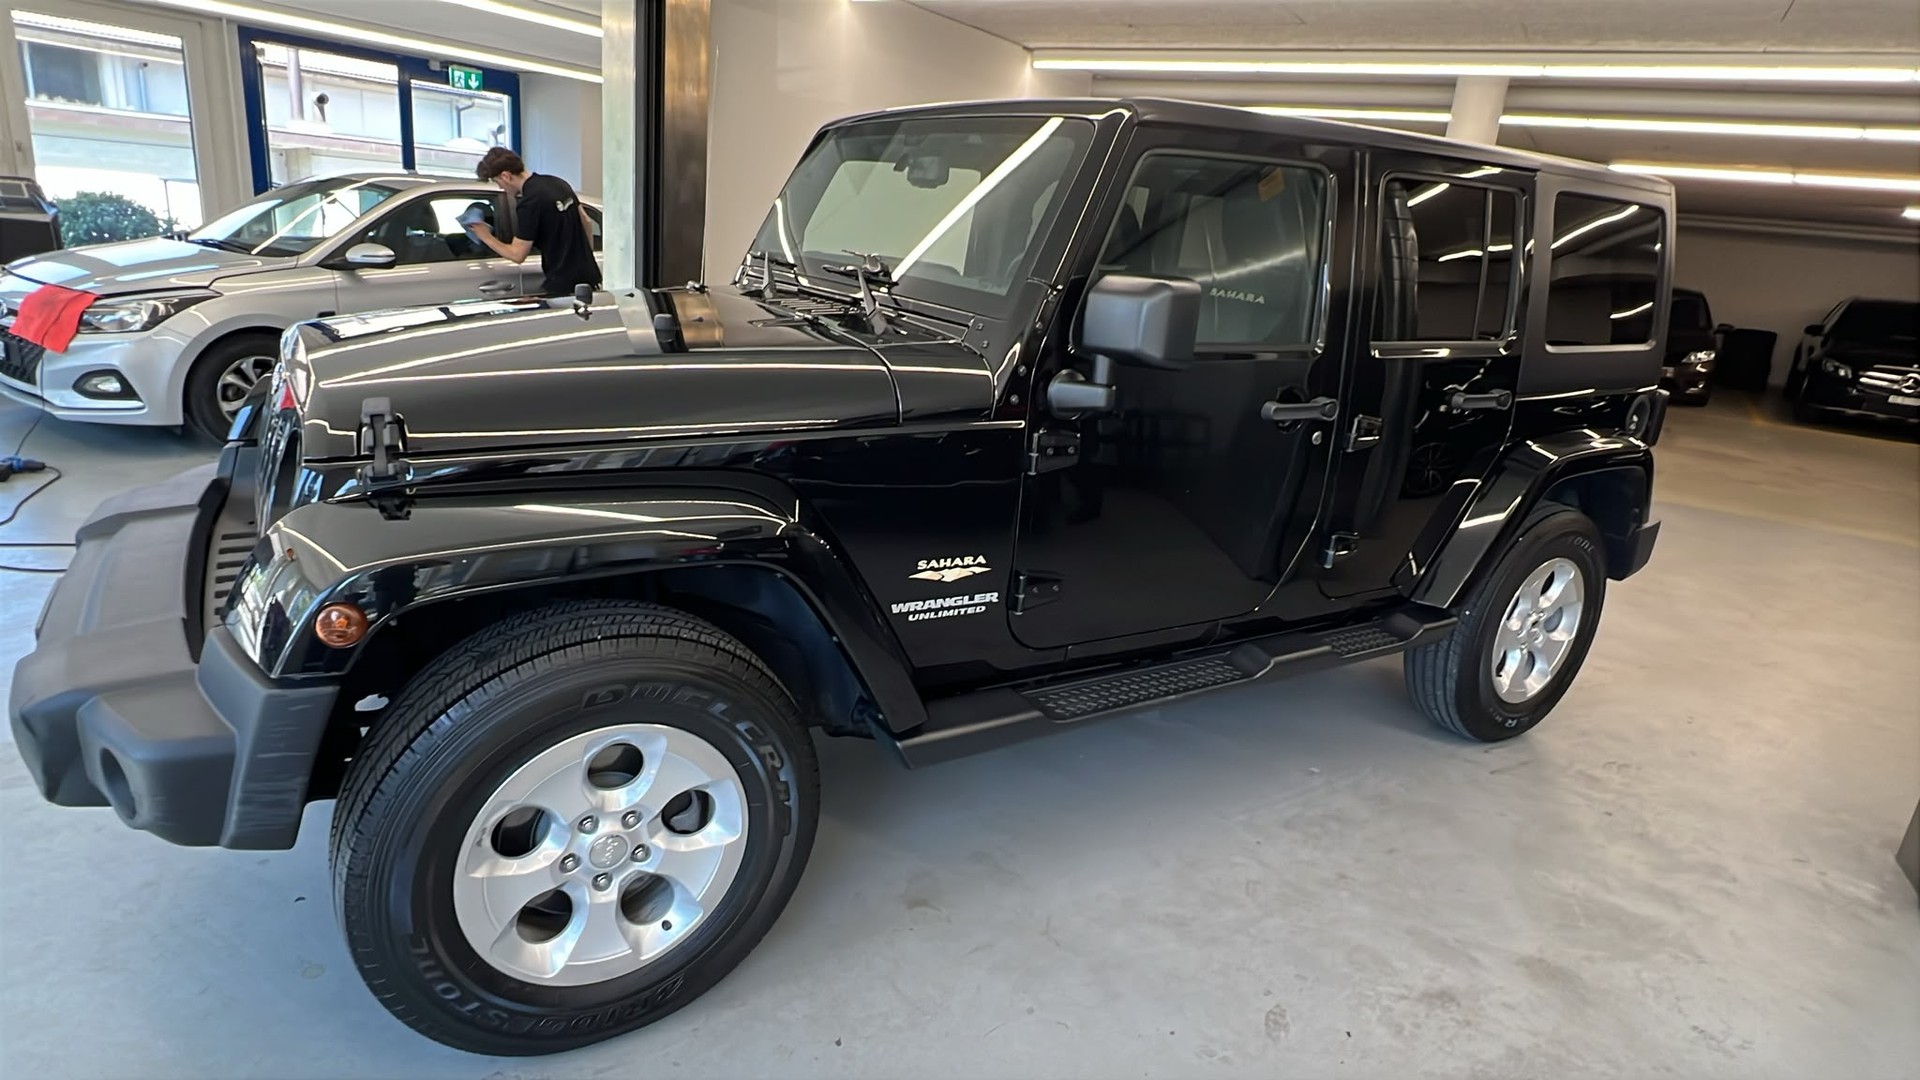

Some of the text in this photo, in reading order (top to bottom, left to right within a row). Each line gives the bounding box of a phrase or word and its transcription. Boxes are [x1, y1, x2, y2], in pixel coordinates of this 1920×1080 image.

[917, 555, 987, 570] SAHARA
[891, 592, 999, 614] WRANGLER
[908, 605, 986, 621] UNLIMITED
